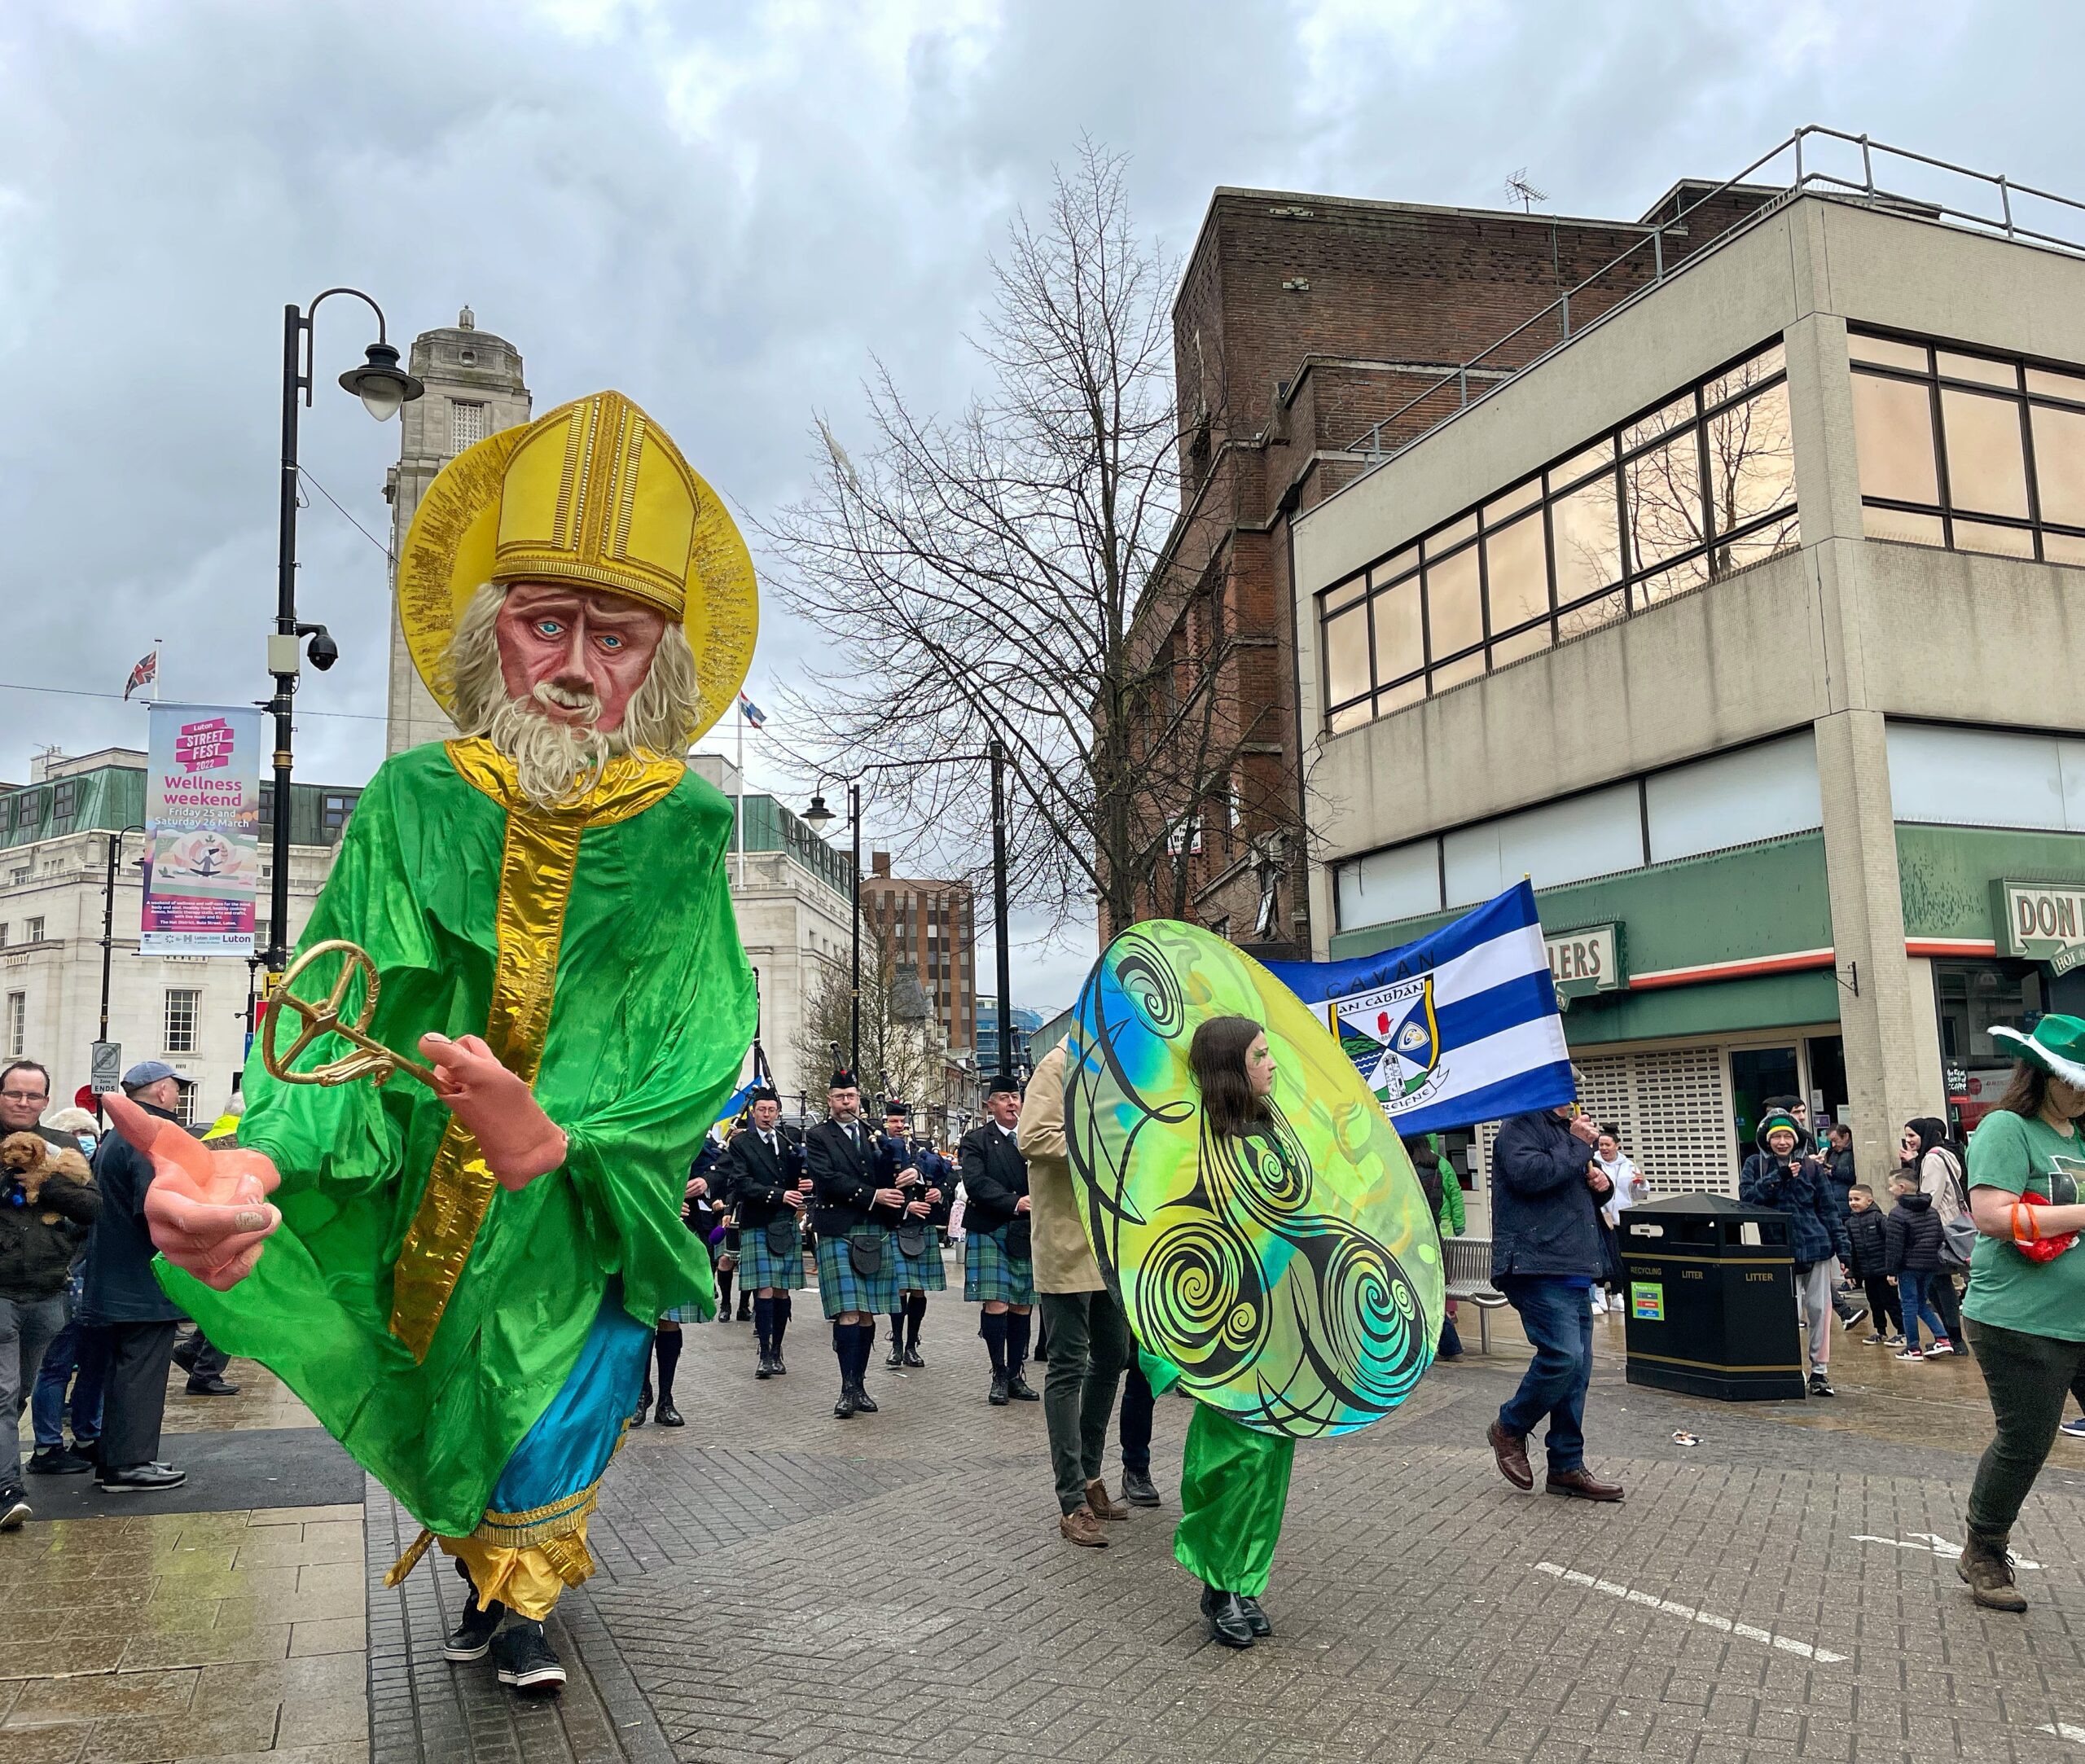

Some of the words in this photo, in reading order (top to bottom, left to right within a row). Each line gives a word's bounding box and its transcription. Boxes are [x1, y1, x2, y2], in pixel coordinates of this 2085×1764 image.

[194, 723, 213, 731] Luton
[187, 730, 225, 748] STREET
[192, 743, 221, 760] FEST
[195, 759, 215, 770] 2022
[165, 775, 242, 792] Wellness
[163, 792, 241, 806] weekend
[169, 808, 200, 818] Friday
[203, 809, 215, 817] 25
[217, 810, 236, 818] and
[155, 816, 200, 827] Saturday
[217, 819, 249, 827] March
[2016, 895, 2076, 937] DON
[223, 935, 251, 943] Luton
[2056, 951, 2077, 972] HOT
[1326, 950, 1435, 999] CAVAN
[1338, 1002, 1359, 1014] AN
[1365, 981, 1424, 1007] CABHÁN
[1948, 1082, 1967, 1092] coffee
[1631, 1266, 1661, 1275] RECYCLING
[1682, 1270, 1703, 1279] LITTER
[1745, 1273, 1774, 1282] LITTER
